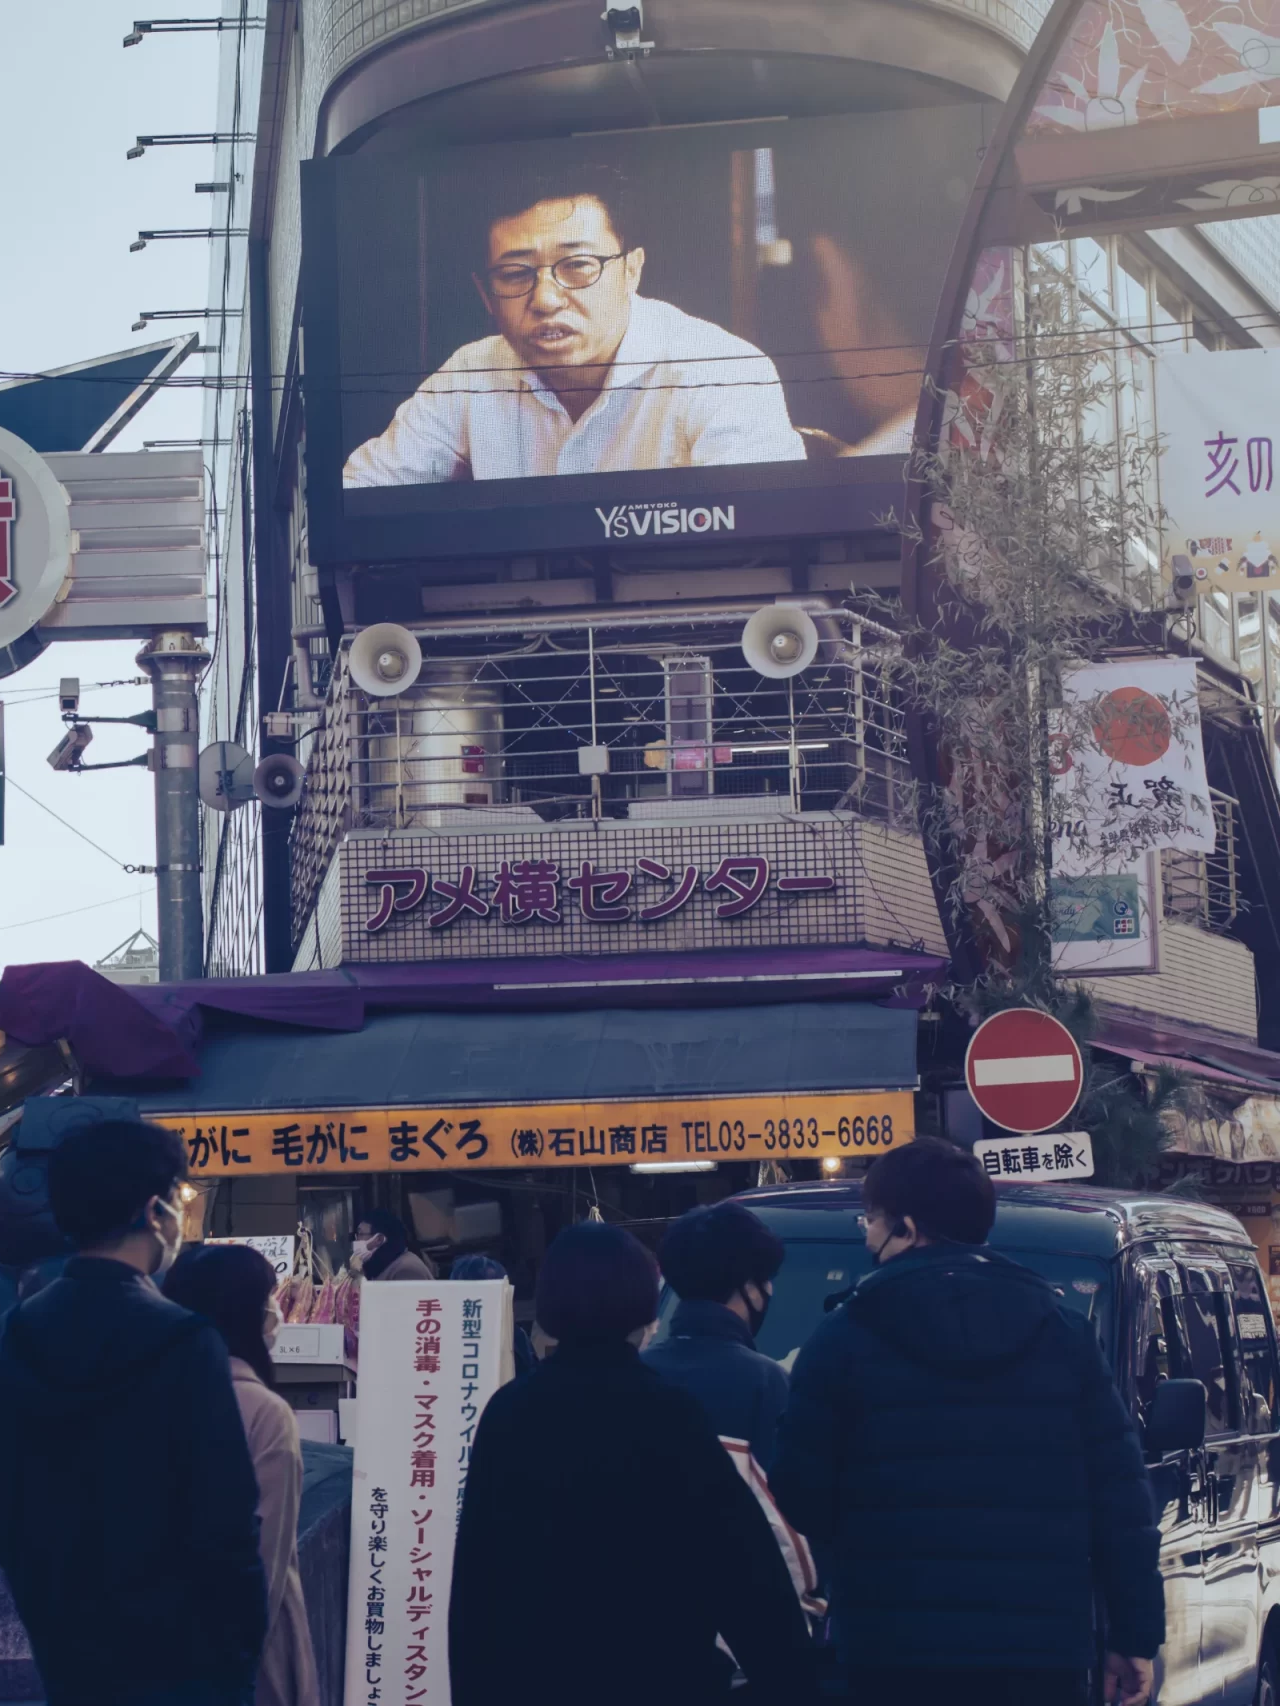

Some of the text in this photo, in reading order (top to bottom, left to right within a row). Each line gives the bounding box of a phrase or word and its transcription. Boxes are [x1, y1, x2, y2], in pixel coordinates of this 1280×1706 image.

[627, 501, 677, 511] AMEYOKO
[364, 855, 836, 932] アメ横センター
[271, 1121, 369, 1166] 毛がに
[387, 1117, 489, 1161] まぐろ
[982, 1142, 1088, 1175] 自転車を除く
[404, 1298, 443, 1706] 手の消毒・マスク着用・ソーシャルディスタン
[365, 1486, 389, 1706] を守り楽しくお買物しましょ
